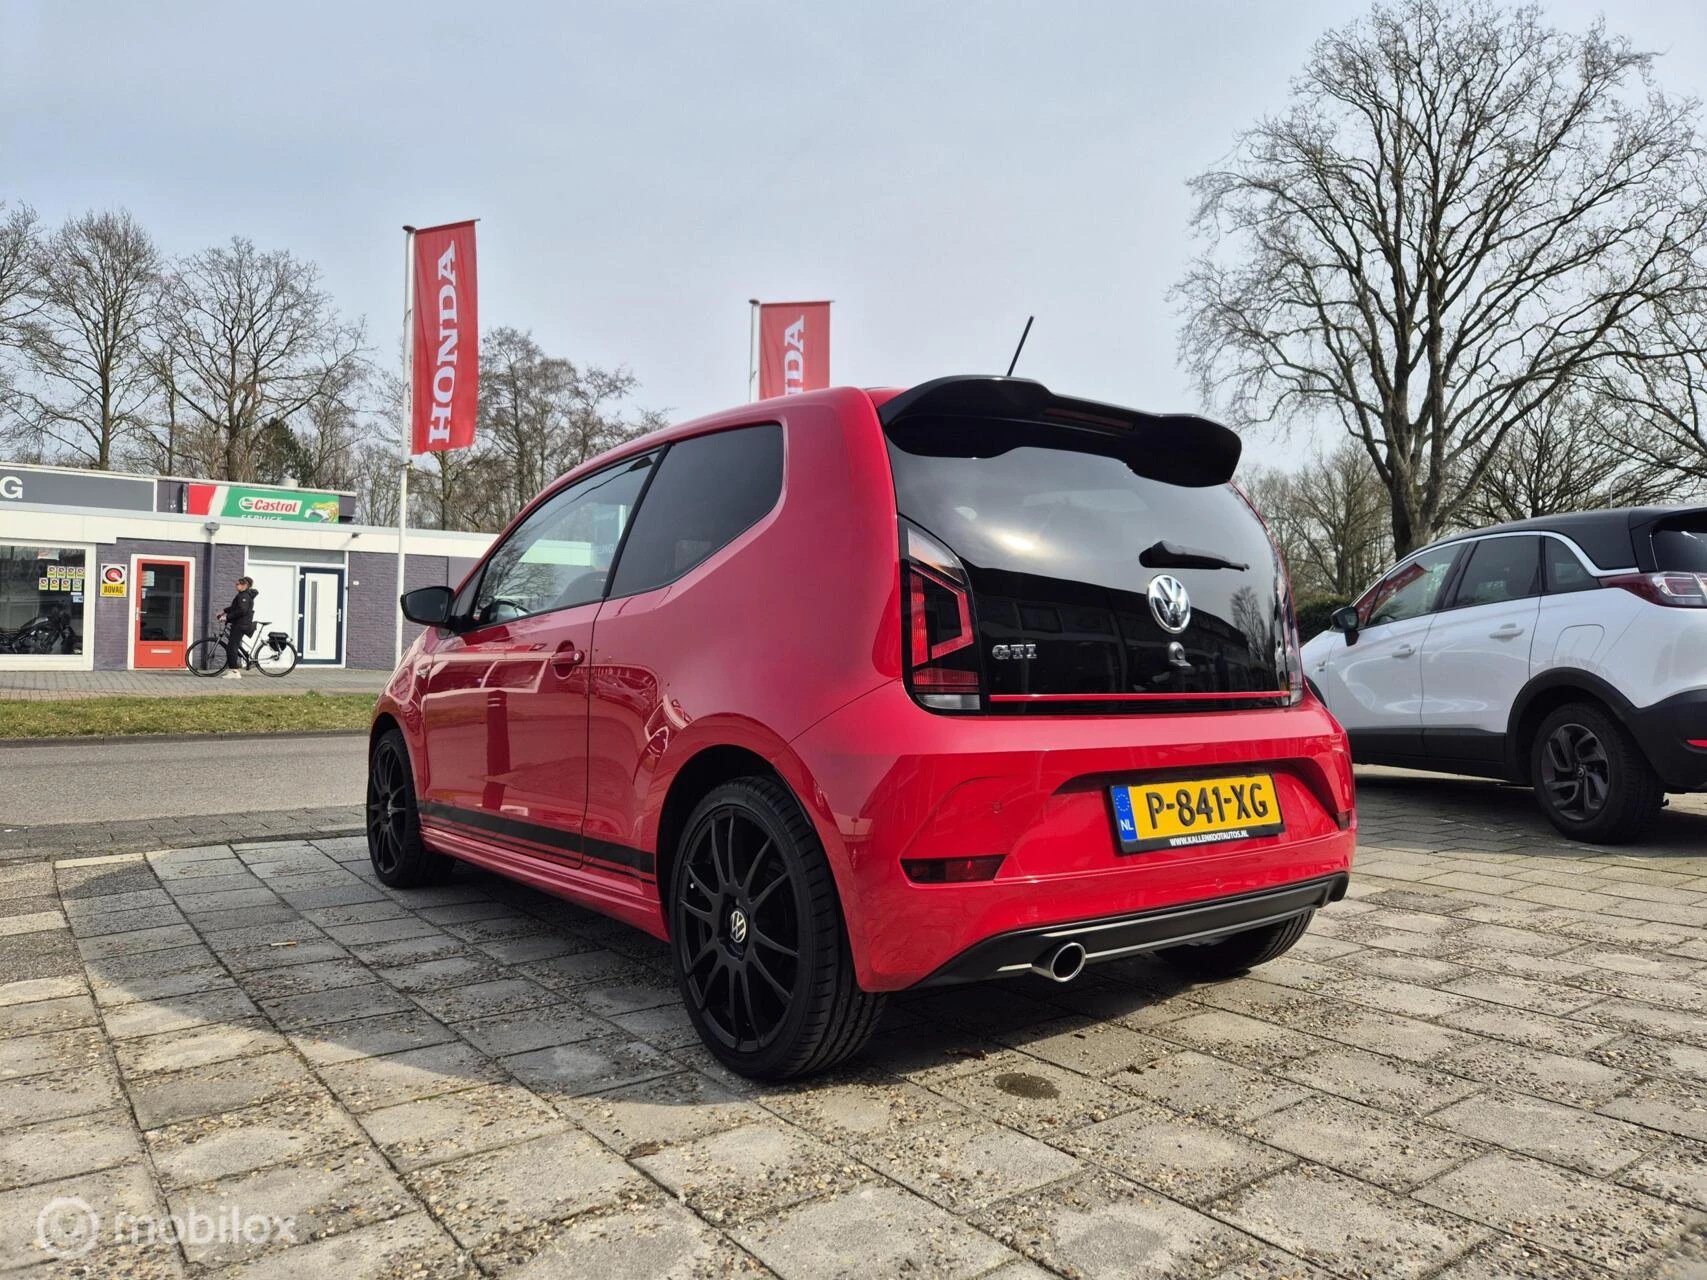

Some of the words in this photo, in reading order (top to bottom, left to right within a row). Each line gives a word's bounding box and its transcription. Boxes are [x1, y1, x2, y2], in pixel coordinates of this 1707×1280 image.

[429, 240, 458, 443] HONDA
[254, 499, 298, 513] Castrol
[103, 584, 124, 595] BOVAG
[992, 644, 1037, 660] GTI
[1146, 783, 1269, 829] P-841-XG
[1120, 819, 1134, 831] NL
[1169, 830, 1249, 847] WWW.KALLENKOOTAUTOS.NL
